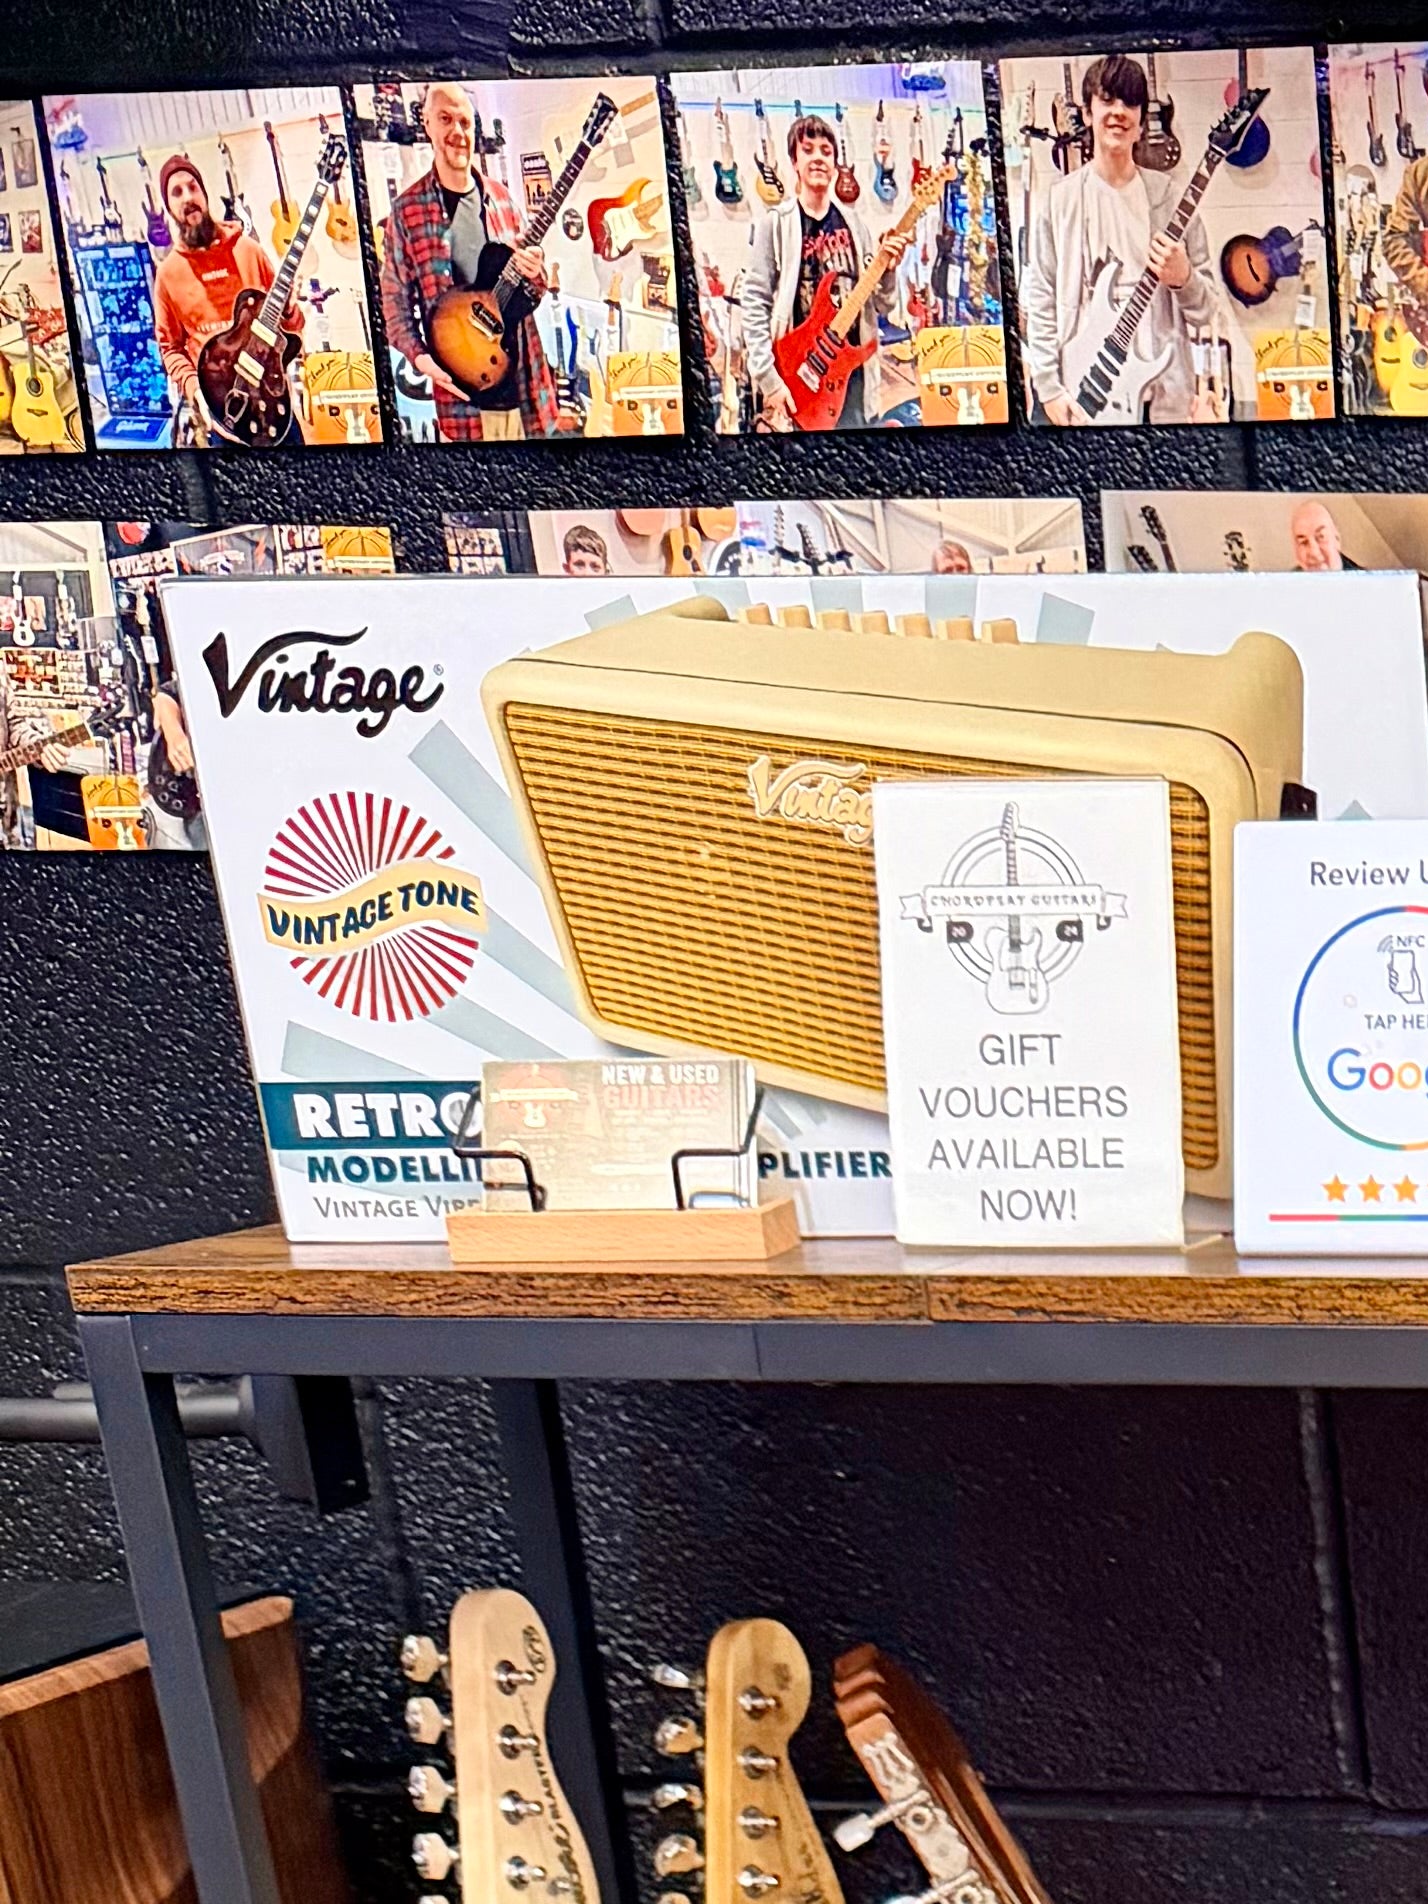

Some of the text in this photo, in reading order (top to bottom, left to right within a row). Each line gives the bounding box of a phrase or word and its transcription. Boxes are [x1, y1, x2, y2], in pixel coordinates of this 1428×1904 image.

[202, 626, 444, 738] Vintage
[748, 753, 876, 848] Vintag
[1308, 860, 1410, 887] Review
[267, 880, 481, 946] VINTAGE TONE
[1396, 935, 1426, 948] NFC
[1364, 1014, 1397, 1031] TAP
[978, 1034, 1062, 1067] GIFT
[602, 1063, 720, 1086] NEW & USED
[292, 1091, 482, 1140] RETRO
[918, 1084, 1129, 1119] VOUCHERS
[308, 1154, 482, 1184] MODELLI
[757, 1150, 892, 1180] PLIFIER
[928, 1136, 1125, 1170] AVAILABLE
[312, 1196, 419, 1219] VINTAGE
[979, 1187, 1078, 1220] NOW!
